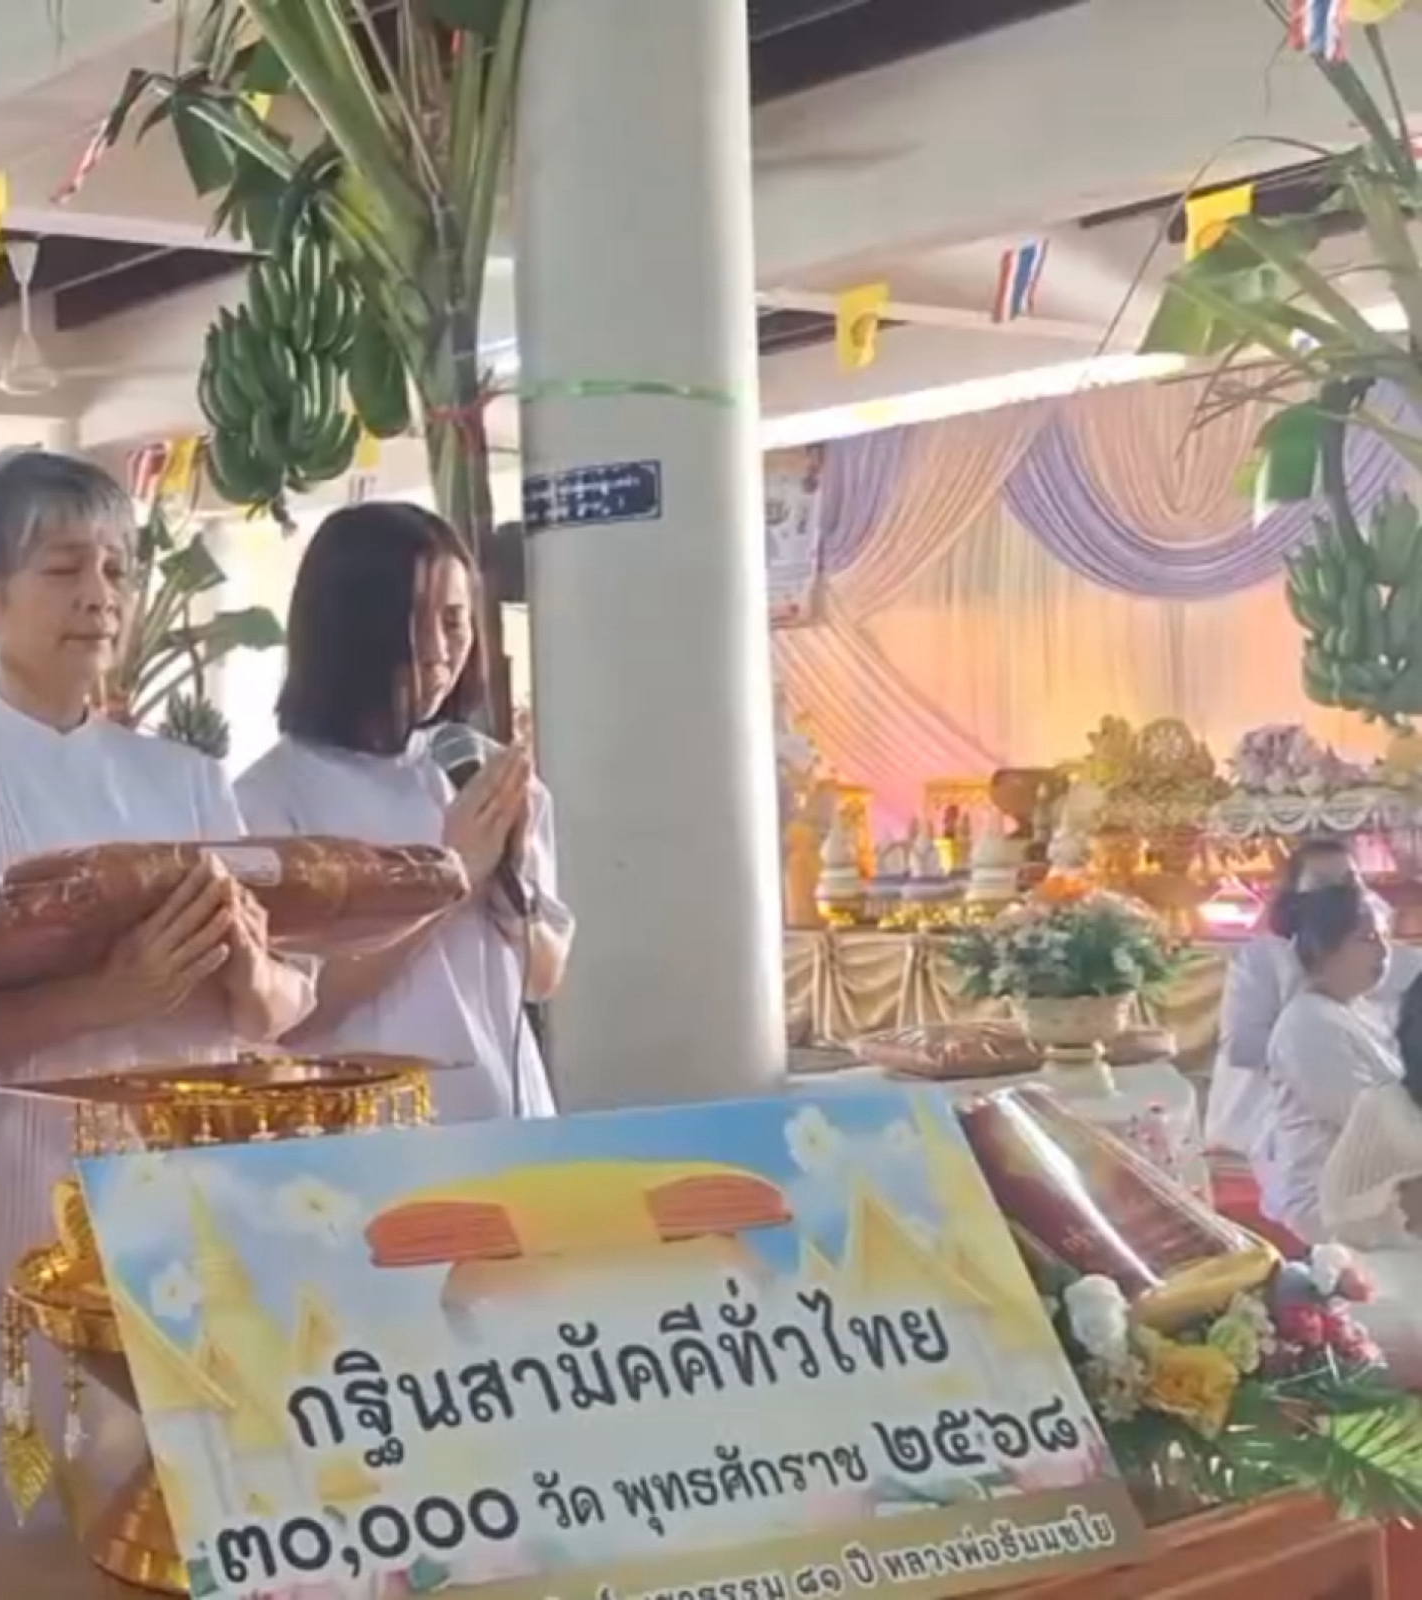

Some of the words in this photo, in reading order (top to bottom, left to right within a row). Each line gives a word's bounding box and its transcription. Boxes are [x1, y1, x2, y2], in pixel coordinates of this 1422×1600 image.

[286, 1277, 950, 1469] กฐินสามัคคีทั่วไทย
[215, 1487, 520, 1584] ๓๐,๐๐๐
[533, 1470, 606, 1529] วัด
[612, 1443, 869, 1537] พุทธศักราช
[871, 1394, 1079, 1475] ๒๕๖๘
[844, 1546, 874, 1584] ปี
